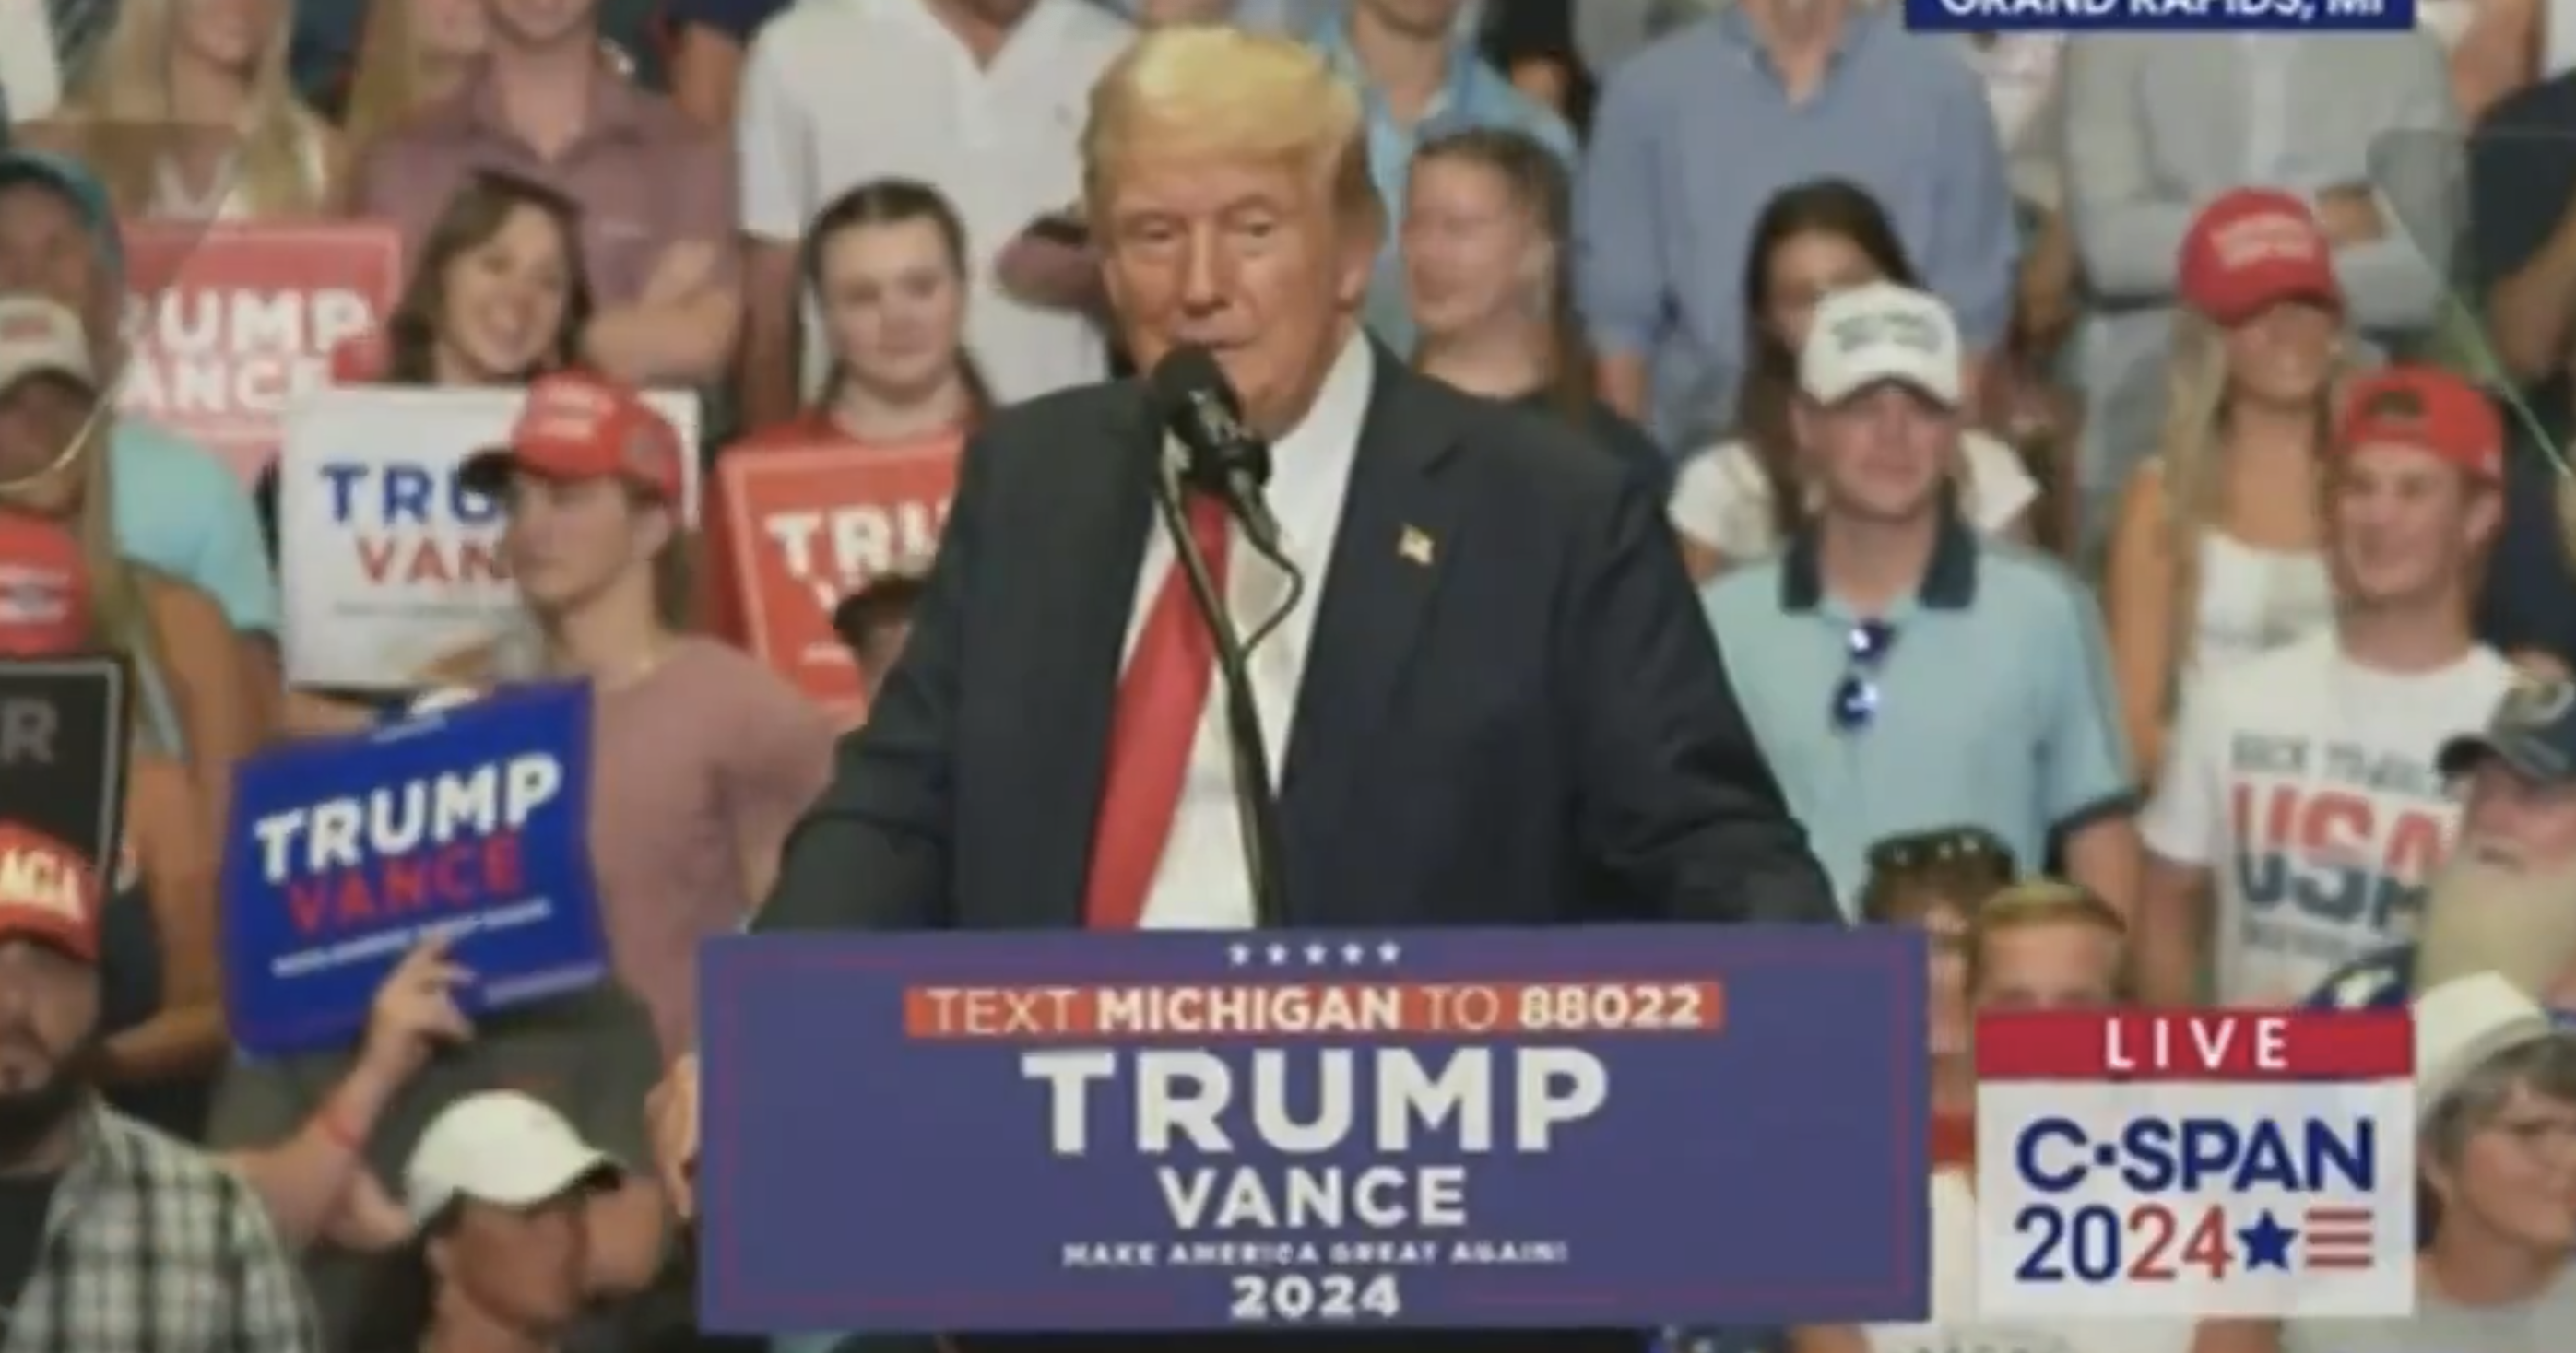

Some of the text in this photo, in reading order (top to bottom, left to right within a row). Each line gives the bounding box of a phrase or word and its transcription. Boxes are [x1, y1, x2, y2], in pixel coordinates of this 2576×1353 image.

[320, 461, 505, 527] TRU
[356, 535, 510, 586] VAN
[764, 499, 951, 582] TRU
[254, 751, 562, 883] TRUMP
[0, 844, 86, 924] AGA
[288, 825, 522, 938] VANCE
[928, 983, 1702, 1033] TEXT MICHIGAN TO 88022
[1022, 1047, 1607, 1154] TRUMP
[1159, 1166, 1466, 1229] VANCE
[1063, 1242, 1156, 1266] MAKE
[1168, 1241, 1318, 1265] AMERICA
[1329, 1241, 1436, 1264] GREAT
[1231, 1273, 1400, 1319] 2024
